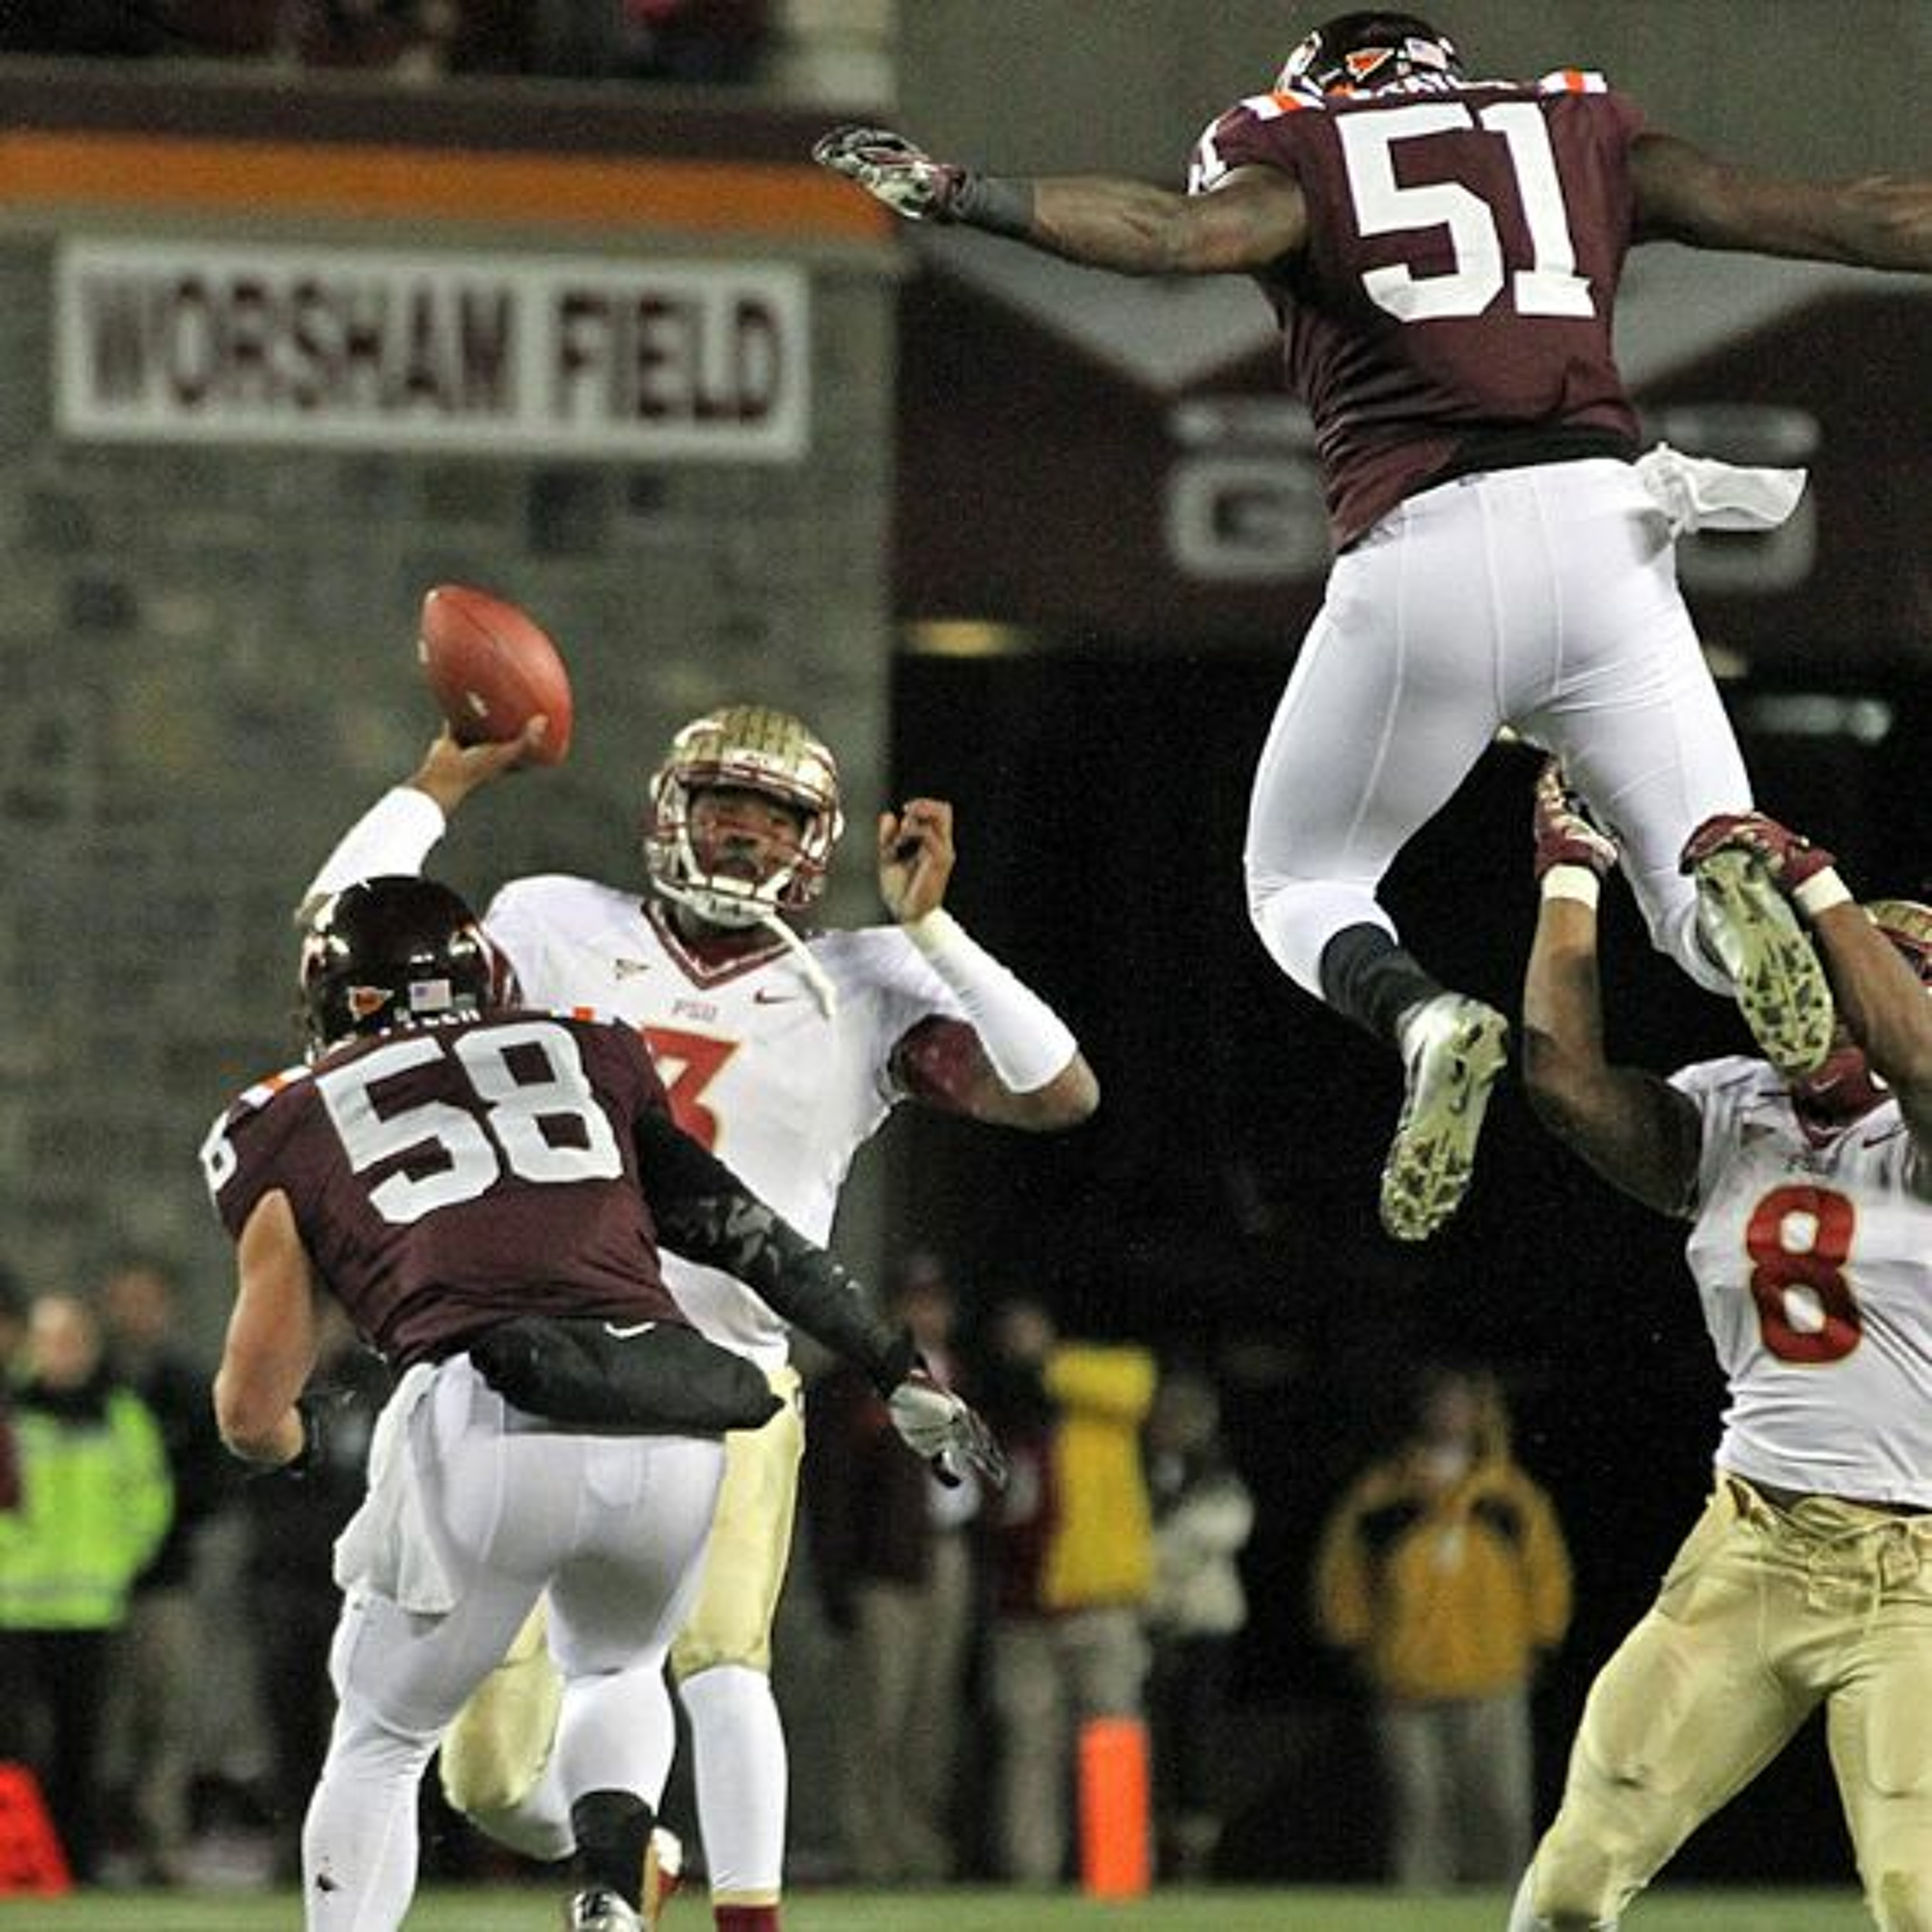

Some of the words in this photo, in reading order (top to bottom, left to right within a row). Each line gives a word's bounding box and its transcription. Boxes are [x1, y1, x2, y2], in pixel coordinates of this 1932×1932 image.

[1336, 102, 1596, 322] 51
[558, 289, 779, 424] FIELD
[316, 1021, 625, 1224] 58
[1745, 1183, 1864, 1365] 8
